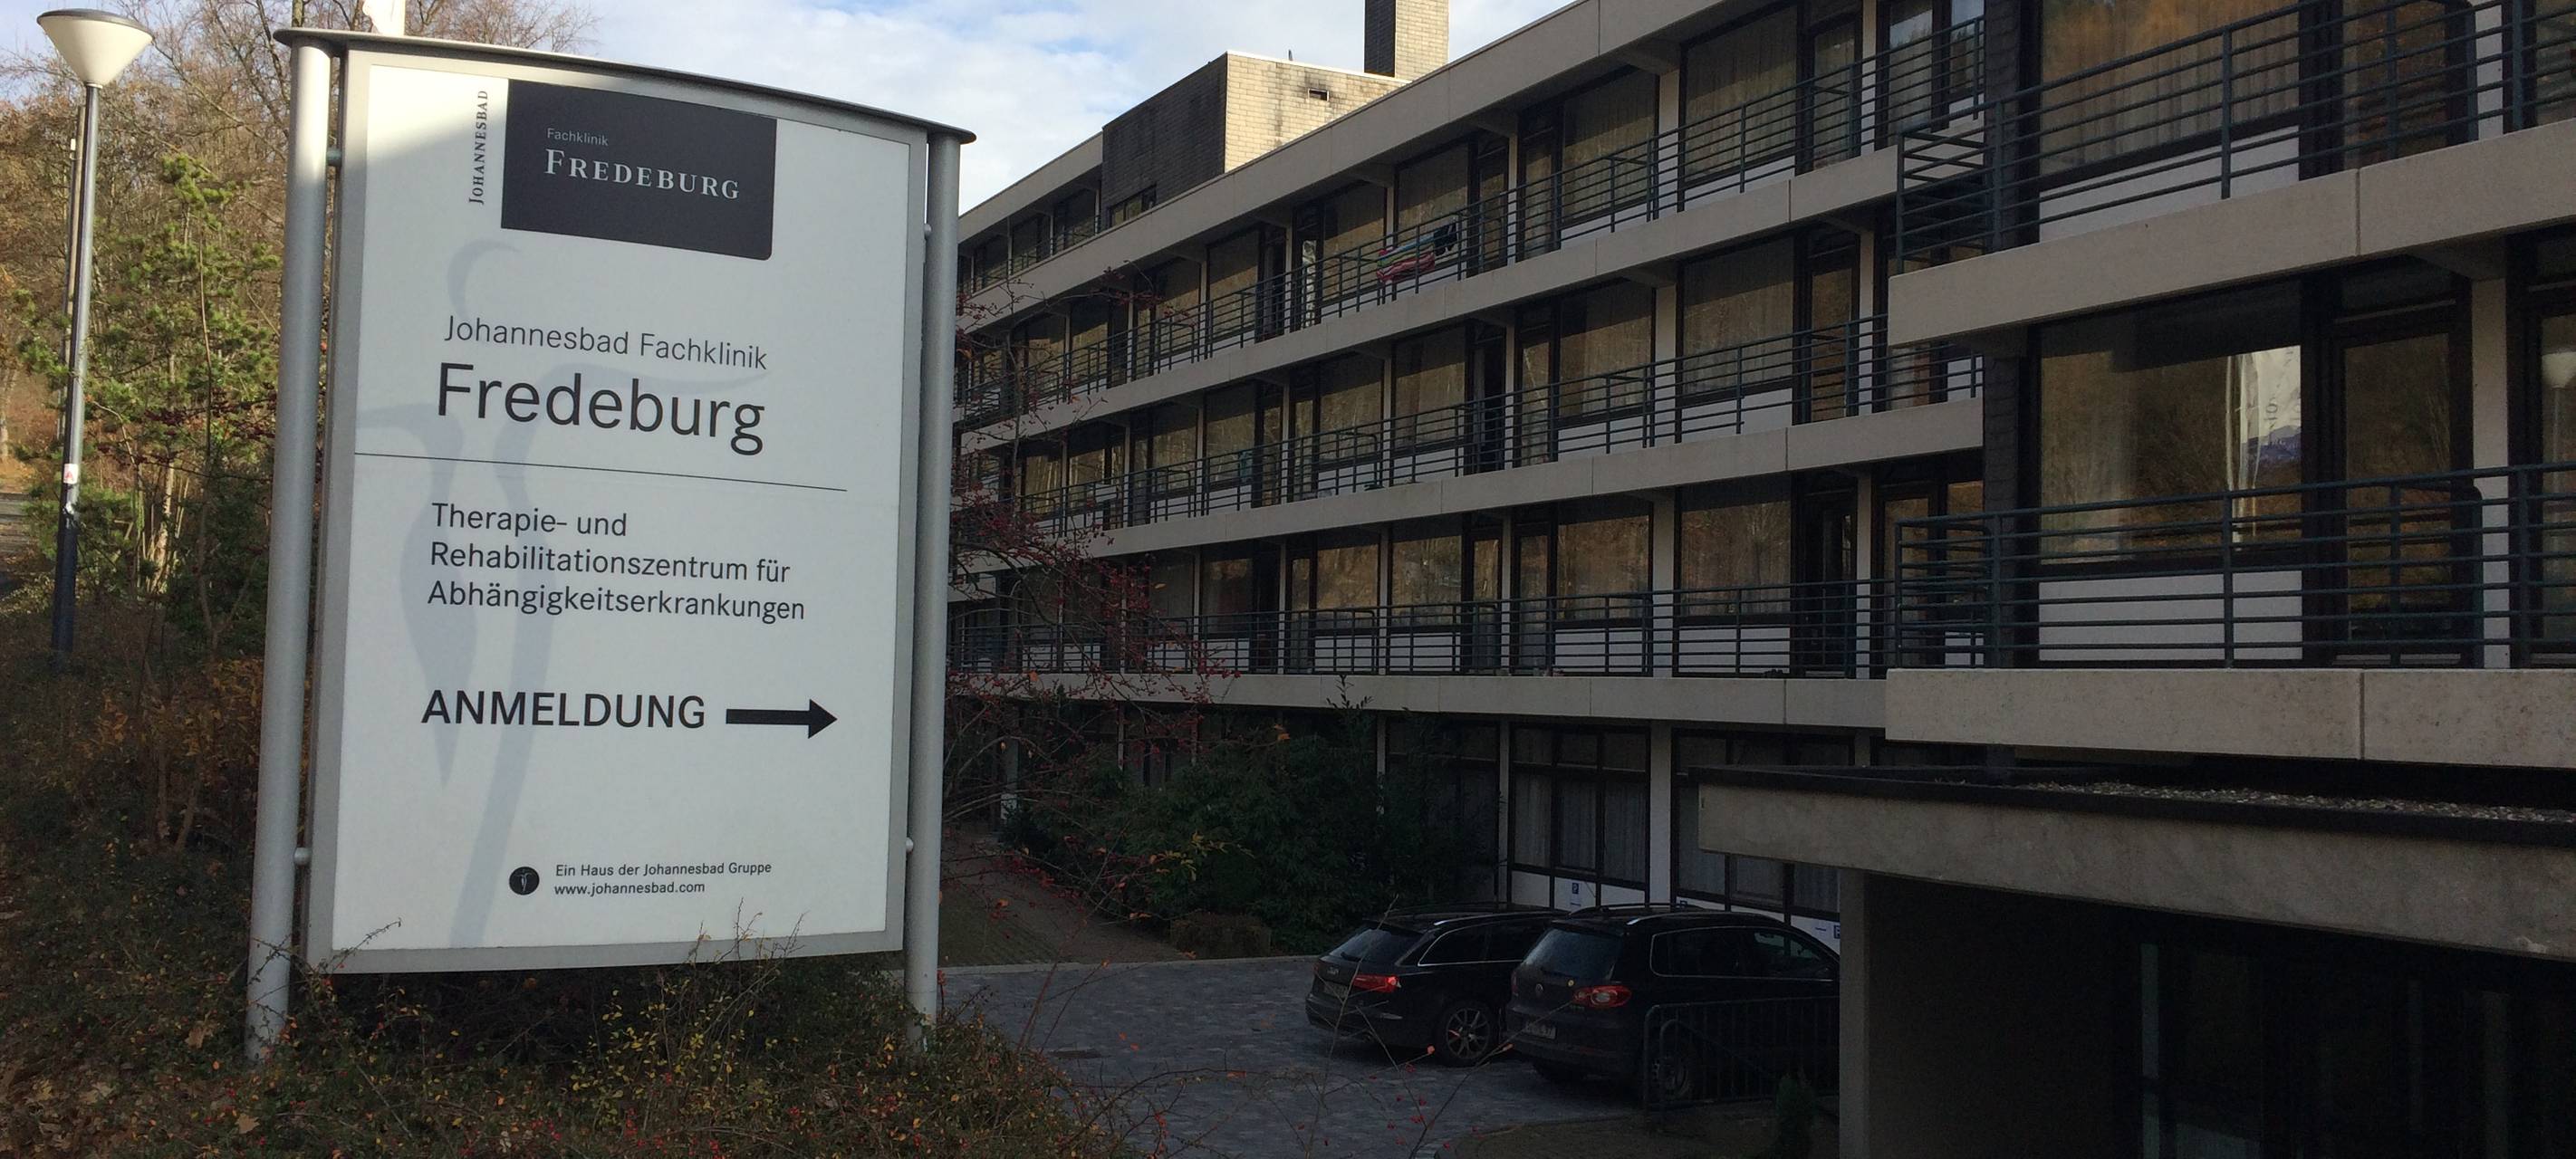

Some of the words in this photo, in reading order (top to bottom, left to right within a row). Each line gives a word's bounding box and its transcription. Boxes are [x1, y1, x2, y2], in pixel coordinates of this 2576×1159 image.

[468, 90, 488, 206] JOHANNESBAD
[546, 128, 609, 147] Fachklinik
[544, 148, 739, 199] FREDEBURG
[444, 315, 629, 355] Johannesbad
[639, 332, 767, 370] Fachklinik
[437, 361, 766, 456] Fredeburg
[431, 503, 568, 536] Therapie-
[577, 512, 627, 537] und
[431, 541, 748, 581] Rehabilitationszentrum
[756, 558, 791, 583] für
[428, 580, 805, 625] Abhängigkeitserkrankungen
[420, 689, 706, 729] ANMELDUNG
[553, 881, 706, 897] www.johannesbad.com
[555, 864, 576, 876] Ein
[581, 864, 614, 876] Haus
[618, 864, 640, 876] der
[643, 862, 725, 876] Johannesbad
[728, 862, 773, 876] Gruppe
